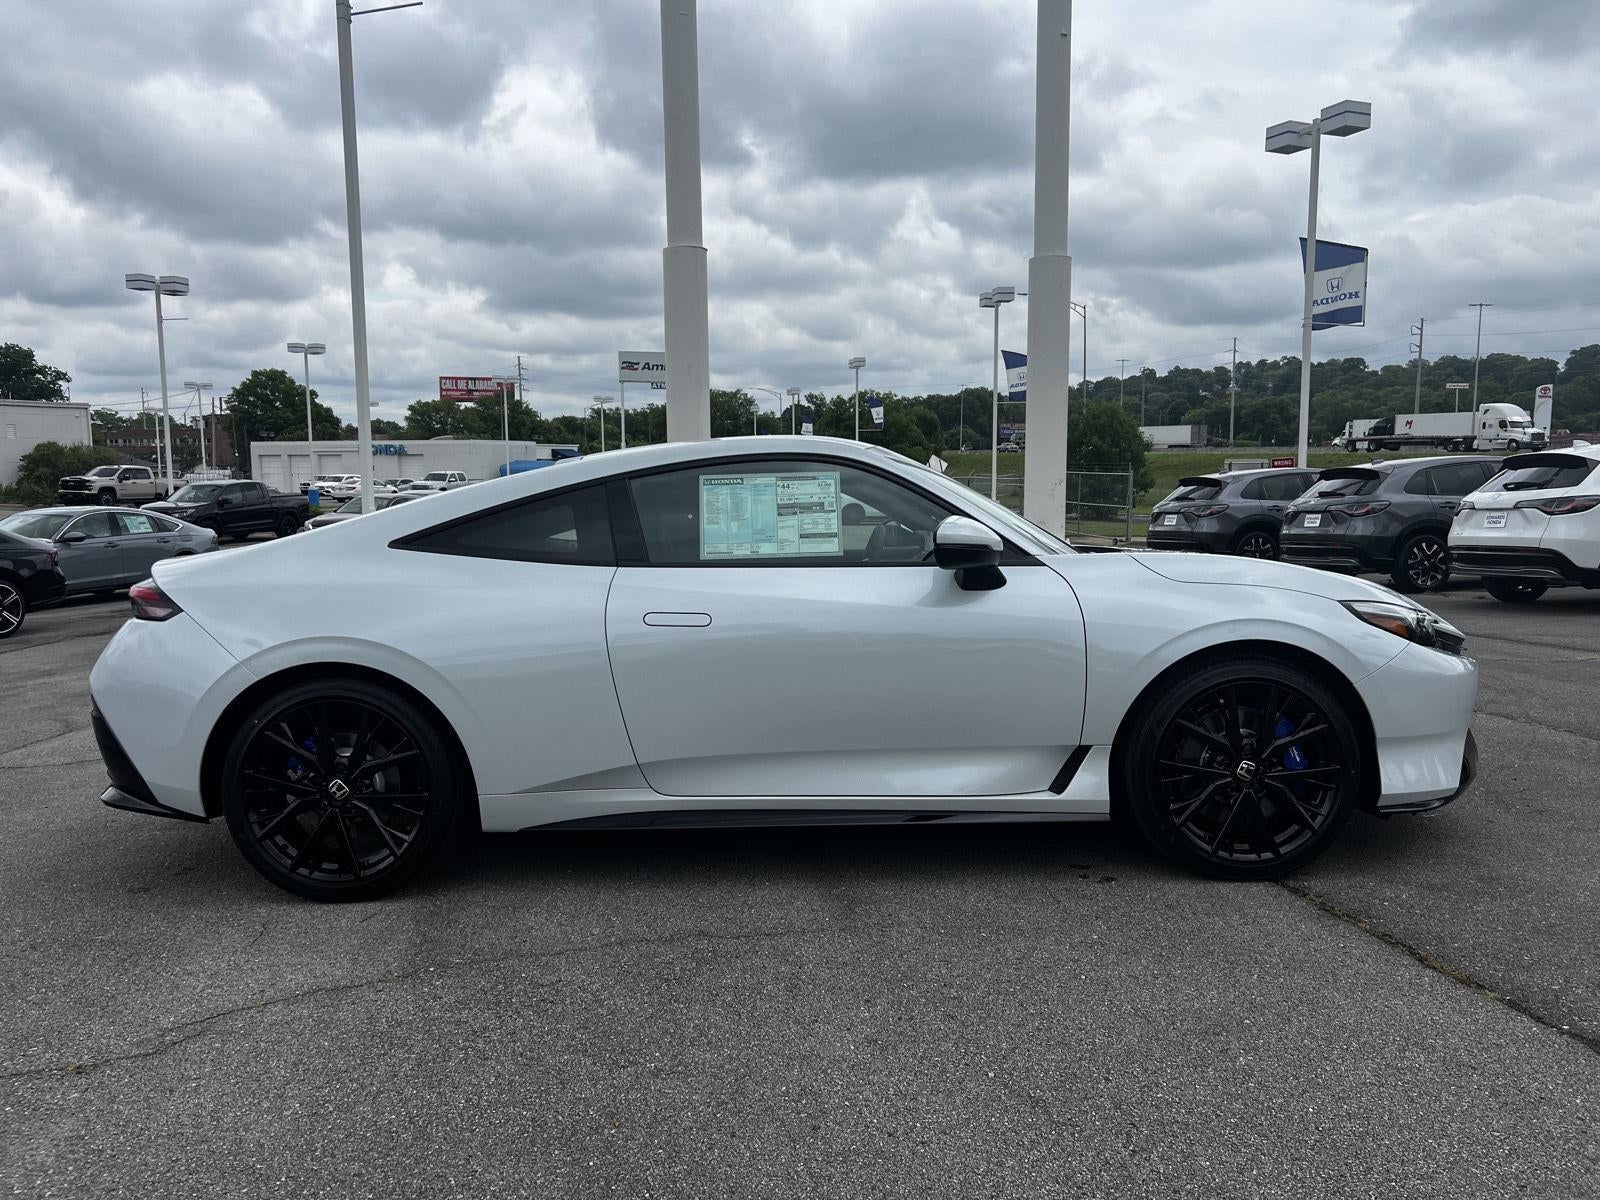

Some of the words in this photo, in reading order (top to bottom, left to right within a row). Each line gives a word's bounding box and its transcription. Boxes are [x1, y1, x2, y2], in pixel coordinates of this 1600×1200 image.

[641, 362, 666, 371] Am
[441, 380, 456, 390] CALL
[458, 380, 467, 390] ME
[371, 444, 407, 456] ONDA
